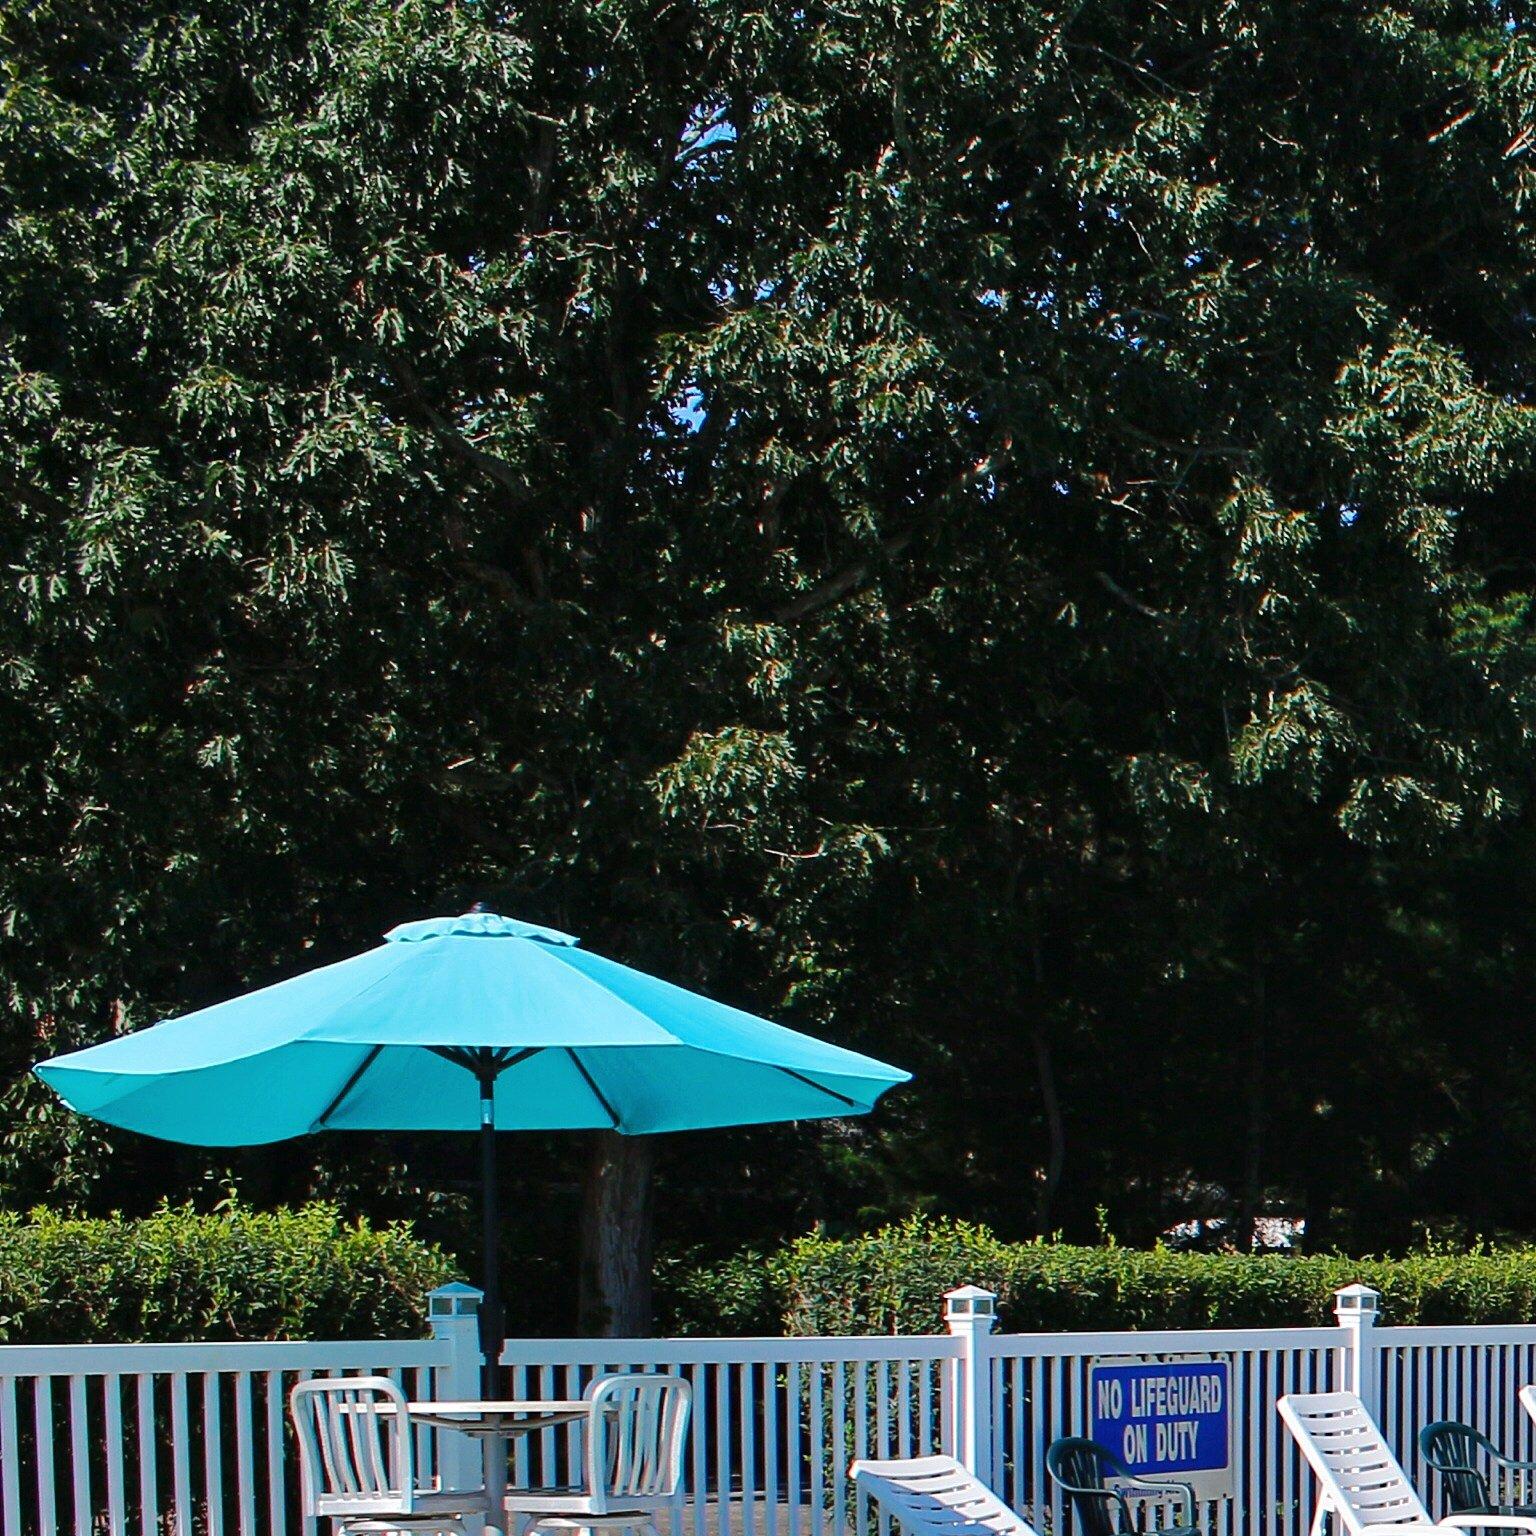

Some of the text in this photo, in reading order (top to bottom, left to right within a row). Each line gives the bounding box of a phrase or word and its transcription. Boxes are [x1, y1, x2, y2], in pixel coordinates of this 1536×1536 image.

[1098, 1375, 1222, 1420] NO LIFEGUARD
[1123, 1421, 1199, 1465] ON DUTY
